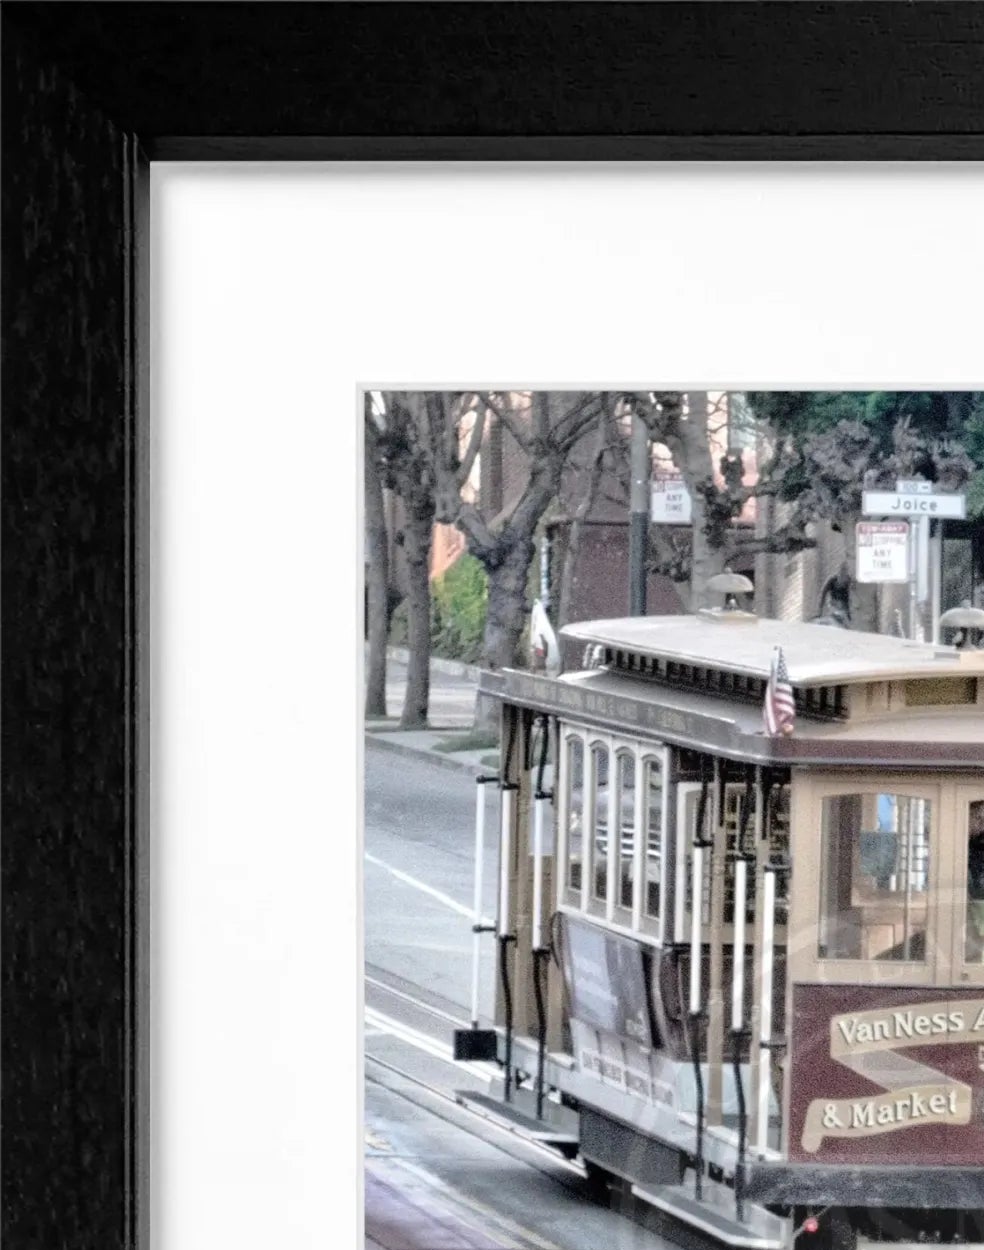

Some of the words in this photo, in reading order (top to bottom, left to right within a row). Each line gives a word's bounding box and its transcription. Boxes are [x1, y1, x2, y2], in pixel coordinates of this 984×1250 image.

[891, 497, 938, 511] Joice
[873, 548, 892, 558] ANY
[872, 559, 893, 569] TIME
[822, 1103, 844, 1129] &
[849, 1089, 959, 1130] Market
